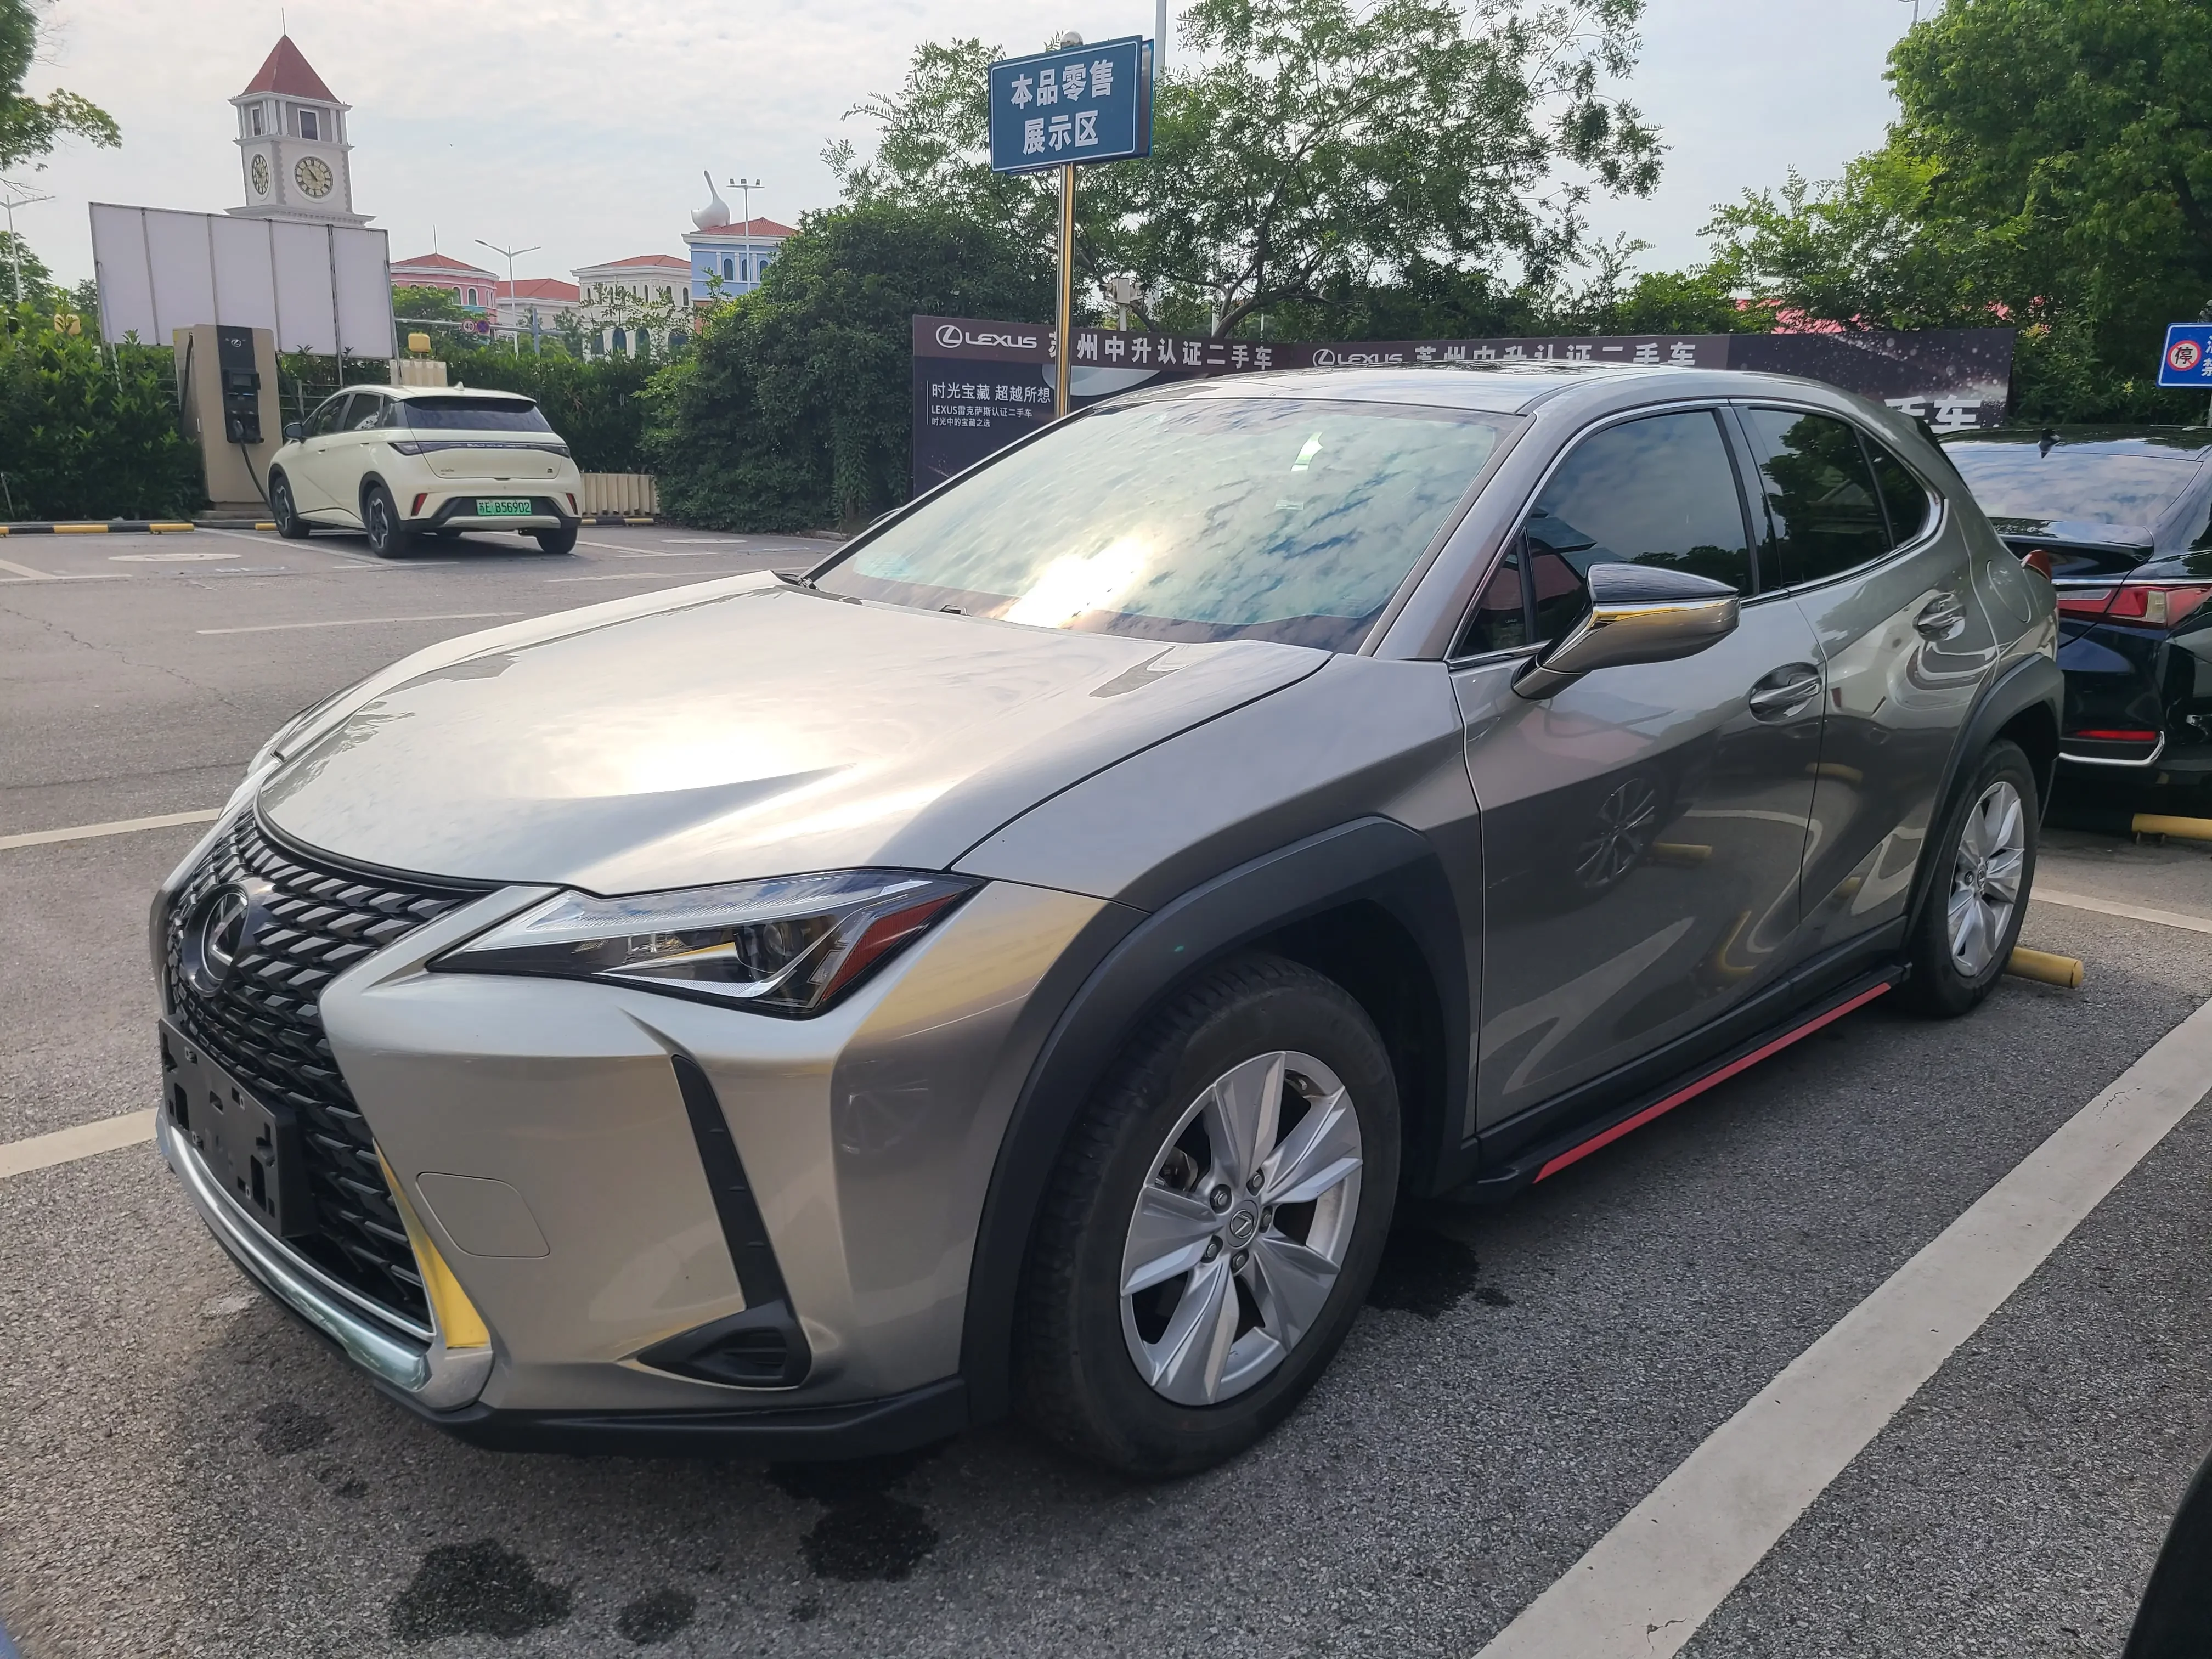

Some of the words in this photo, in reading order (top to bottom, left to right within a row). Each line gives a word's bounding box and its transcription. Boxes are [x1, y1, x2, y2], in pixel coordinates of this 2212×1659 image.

[1011, 59, 1114, 109] 本品零售
[1023, 110, 1098, 155] 展示区
[965, 332, 1037, 348] LEXUS
[932, 382, 990, 401] 时光宝藏
[995, 385, 1051, 403] 超越所想
[932, 417, 991, 427] 时光中的宝藏之选
